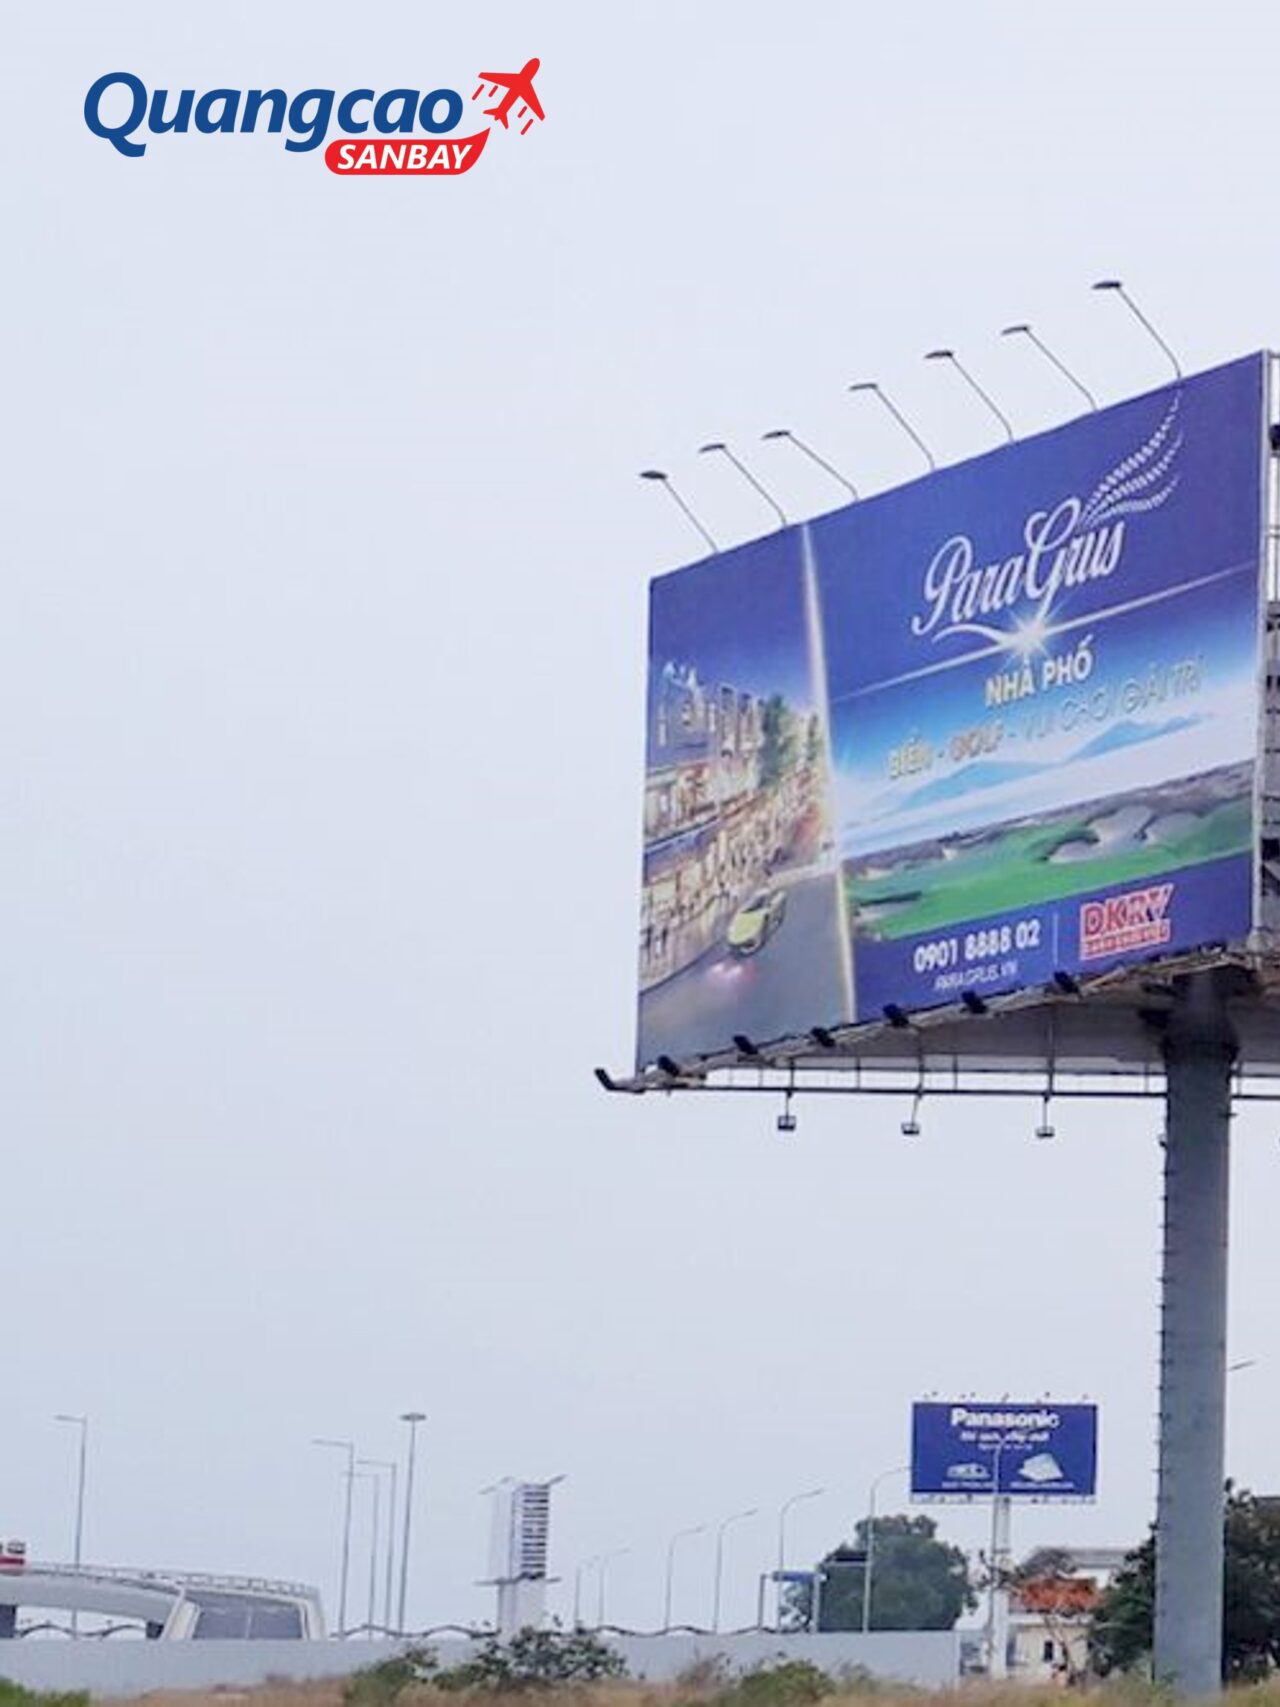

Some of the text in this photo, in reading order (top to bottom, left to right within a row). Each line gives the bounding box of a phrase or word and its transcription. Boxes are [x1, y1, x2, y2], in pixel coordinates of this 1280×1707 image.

[984, 634, 1094, 707] NHÀ PHỐ
[913, 938, 958, 973] 0901
[964, 925, 1012, 960] 8888
[1015, 918, 1040, 949] 02
[951, 1407, 1060, 1429] Panasonic
